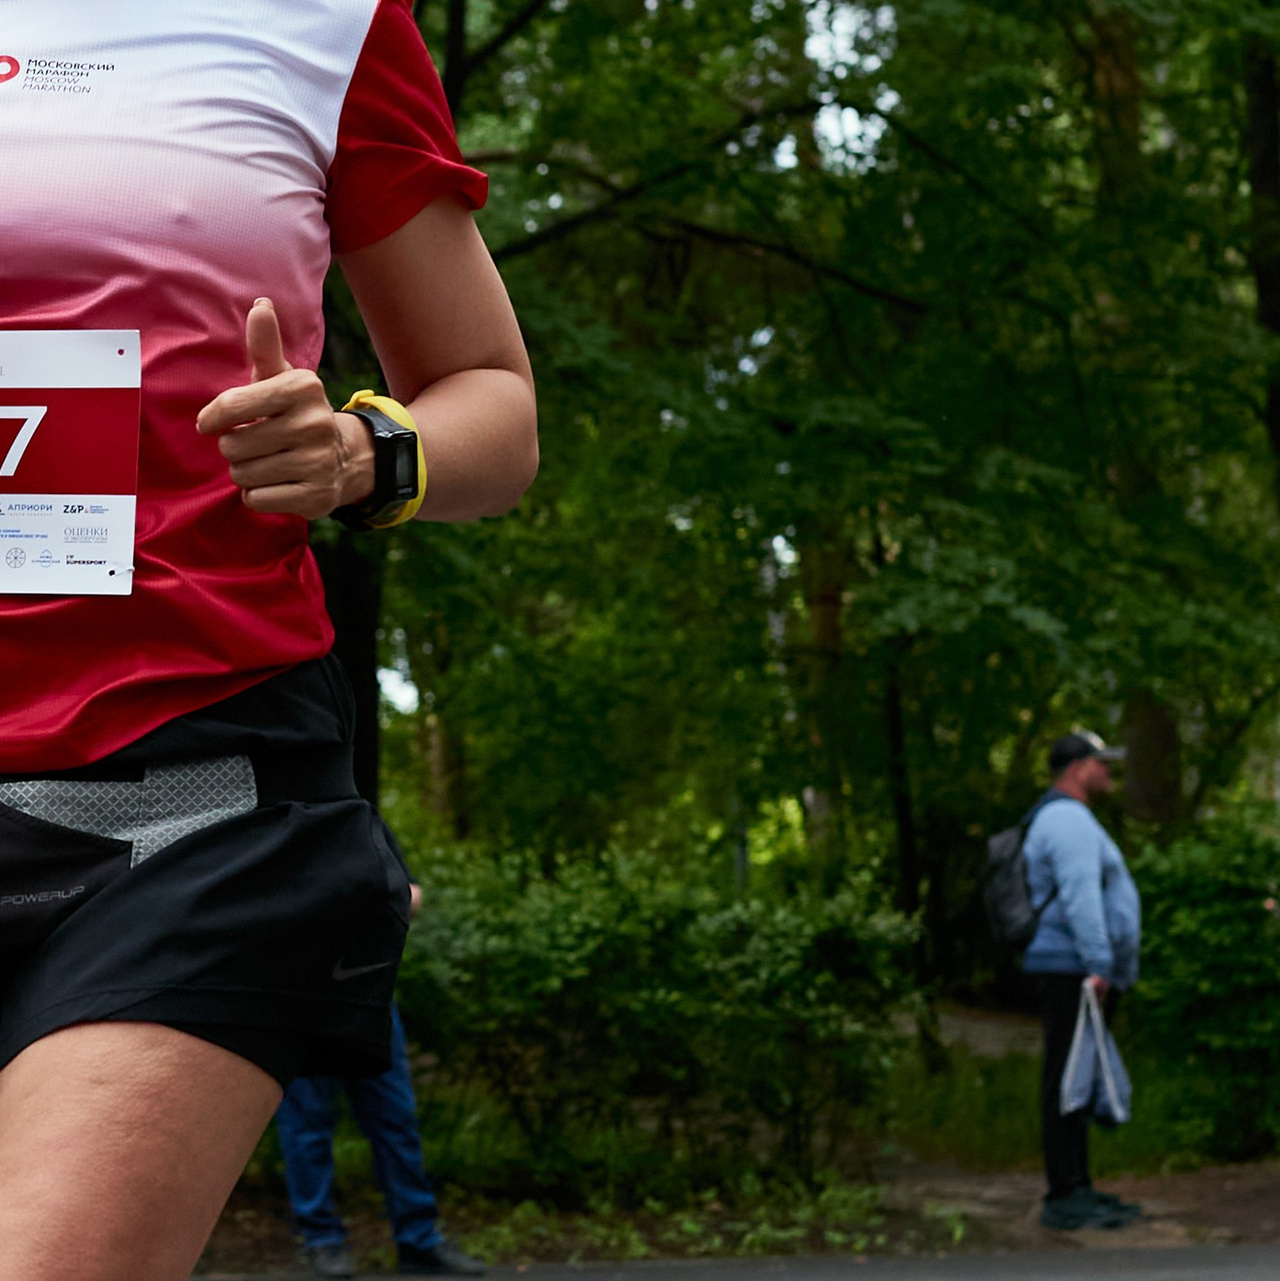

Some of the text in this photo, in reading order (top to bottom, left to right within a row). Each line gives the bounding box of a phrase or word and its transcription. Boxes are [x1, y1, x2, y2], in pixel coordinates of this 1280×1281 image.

[28, 59, 115, 71] МОСКОВСКИЙ
[26, 68, 90, 77] МАРАФОН
[24, 76, 80, 84] MOSCOW
[22, 84, 91, 93] MARATHON
[7, 504, 53, 512] АПРИОРИ
[63, 504, 84, 514] Z&P
[63, 527, 108, 537] ОЦЕНКИ
[0, 885, 85, 906] POWERUP
